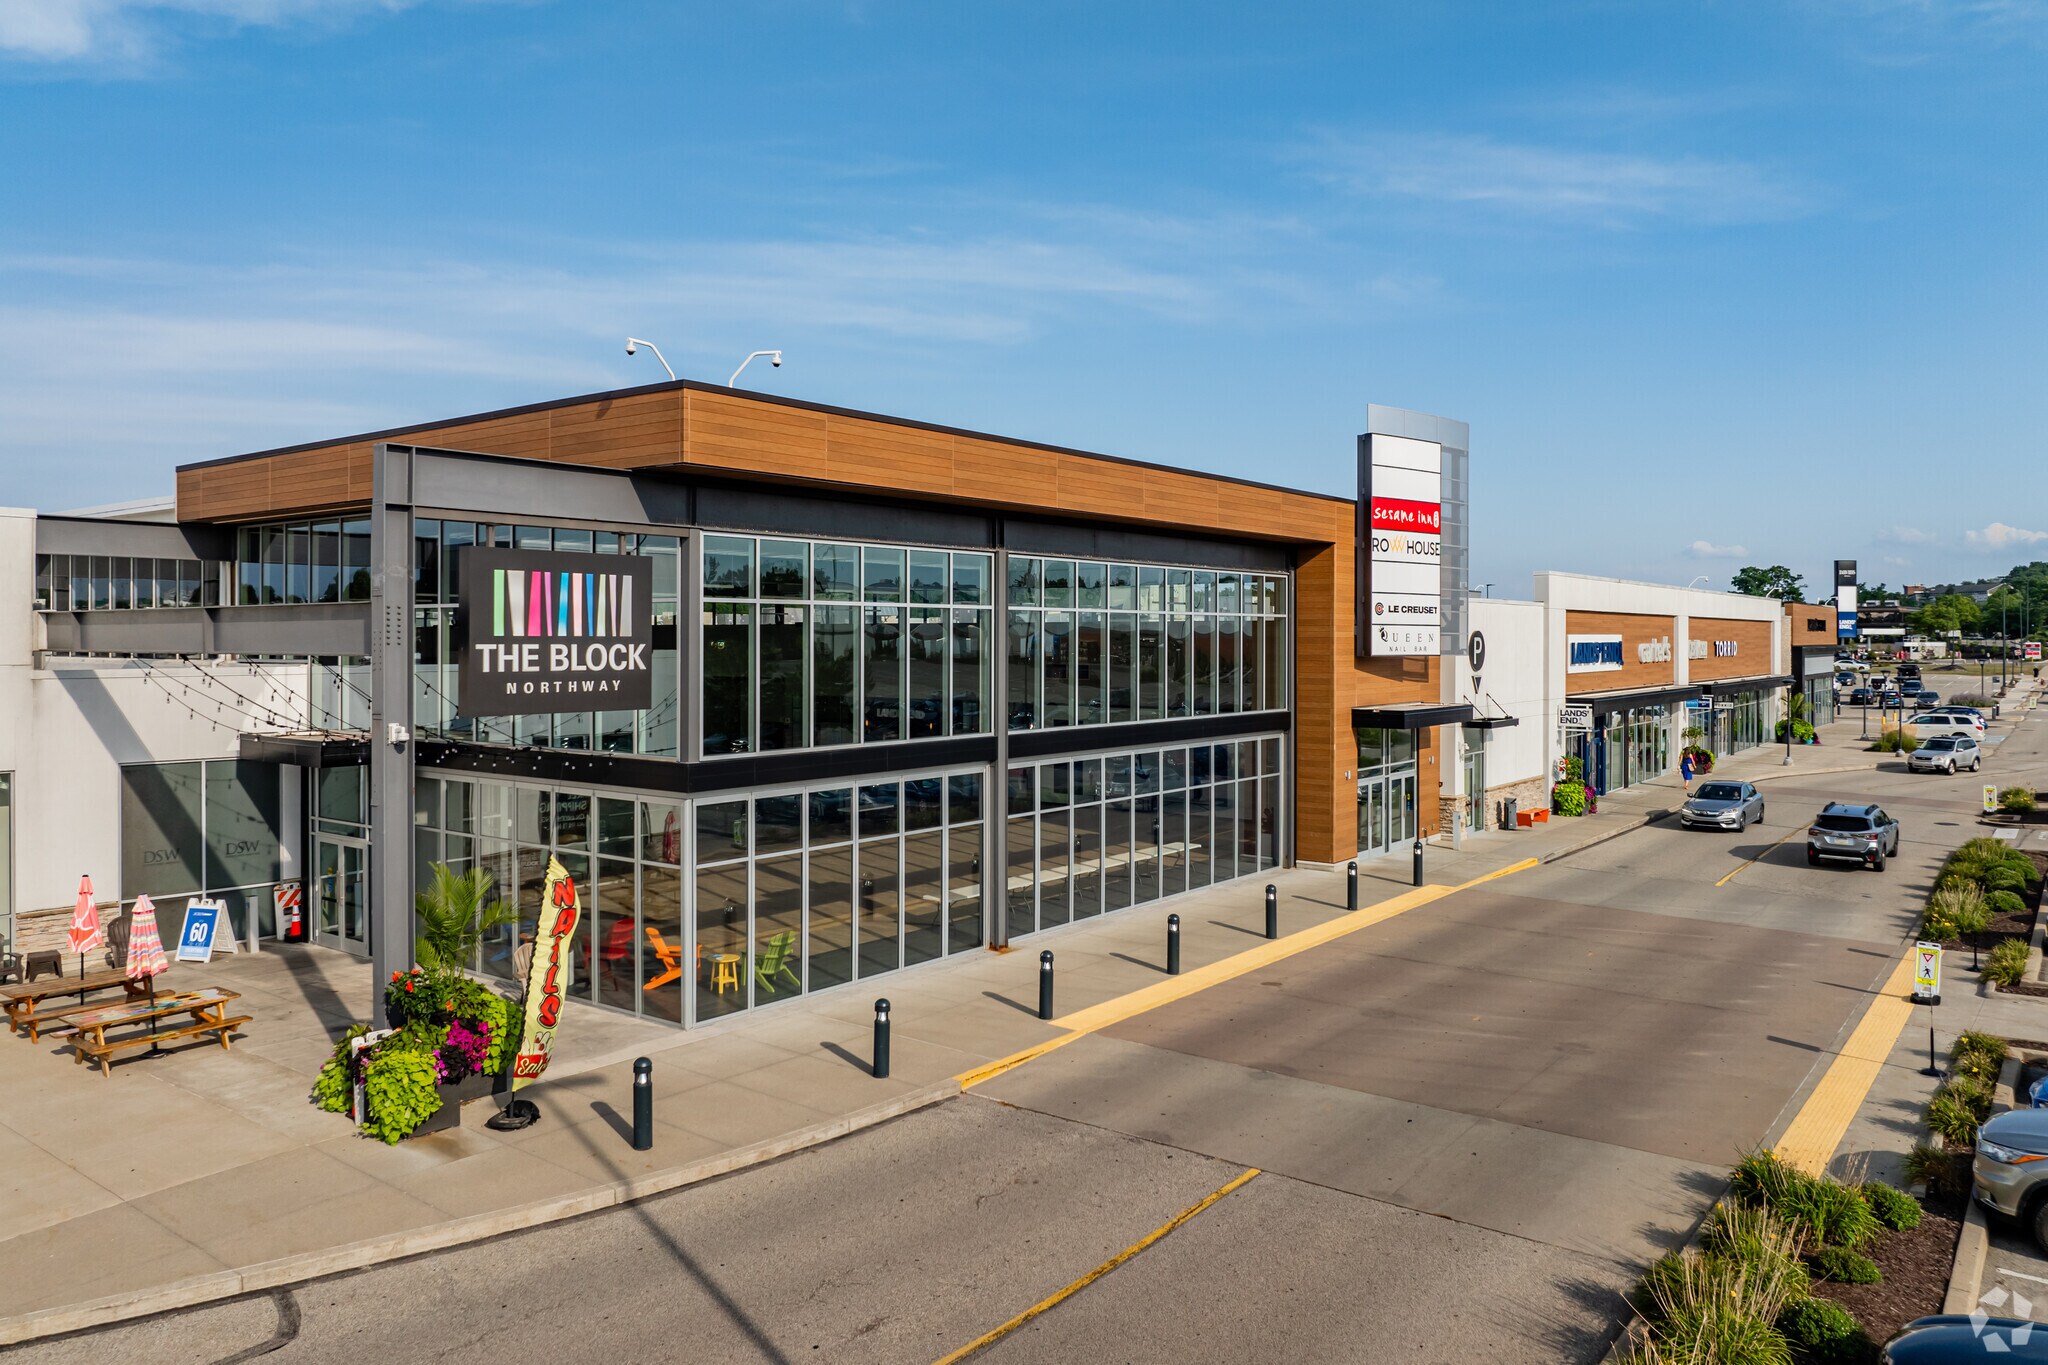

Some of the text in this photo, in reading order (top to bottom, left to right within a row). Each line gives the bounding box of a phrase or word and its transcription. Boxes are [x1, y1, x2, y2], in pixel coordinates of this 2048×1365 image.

[1407, 540, 1440, 556] HOUSE
[1388, 605, 1437, 614] LE CREUSET
[1380, 628, 1434, 643] QUEEN
[1474, 637, 1483, 665] P
[1714, 640, 1738, 657] TORRID
[475, 643, 647, 673] THE BLOCK
[506, 679, 621, 695] NORTHWAY
[1560, 709, 1589, 717] LANDS'
[144, 847, 181, 863] DSW
[226, 839, 260, 855] DSW
[189, 922, 209, 942] 60
[538, 876, 575, 1029] NAILS
